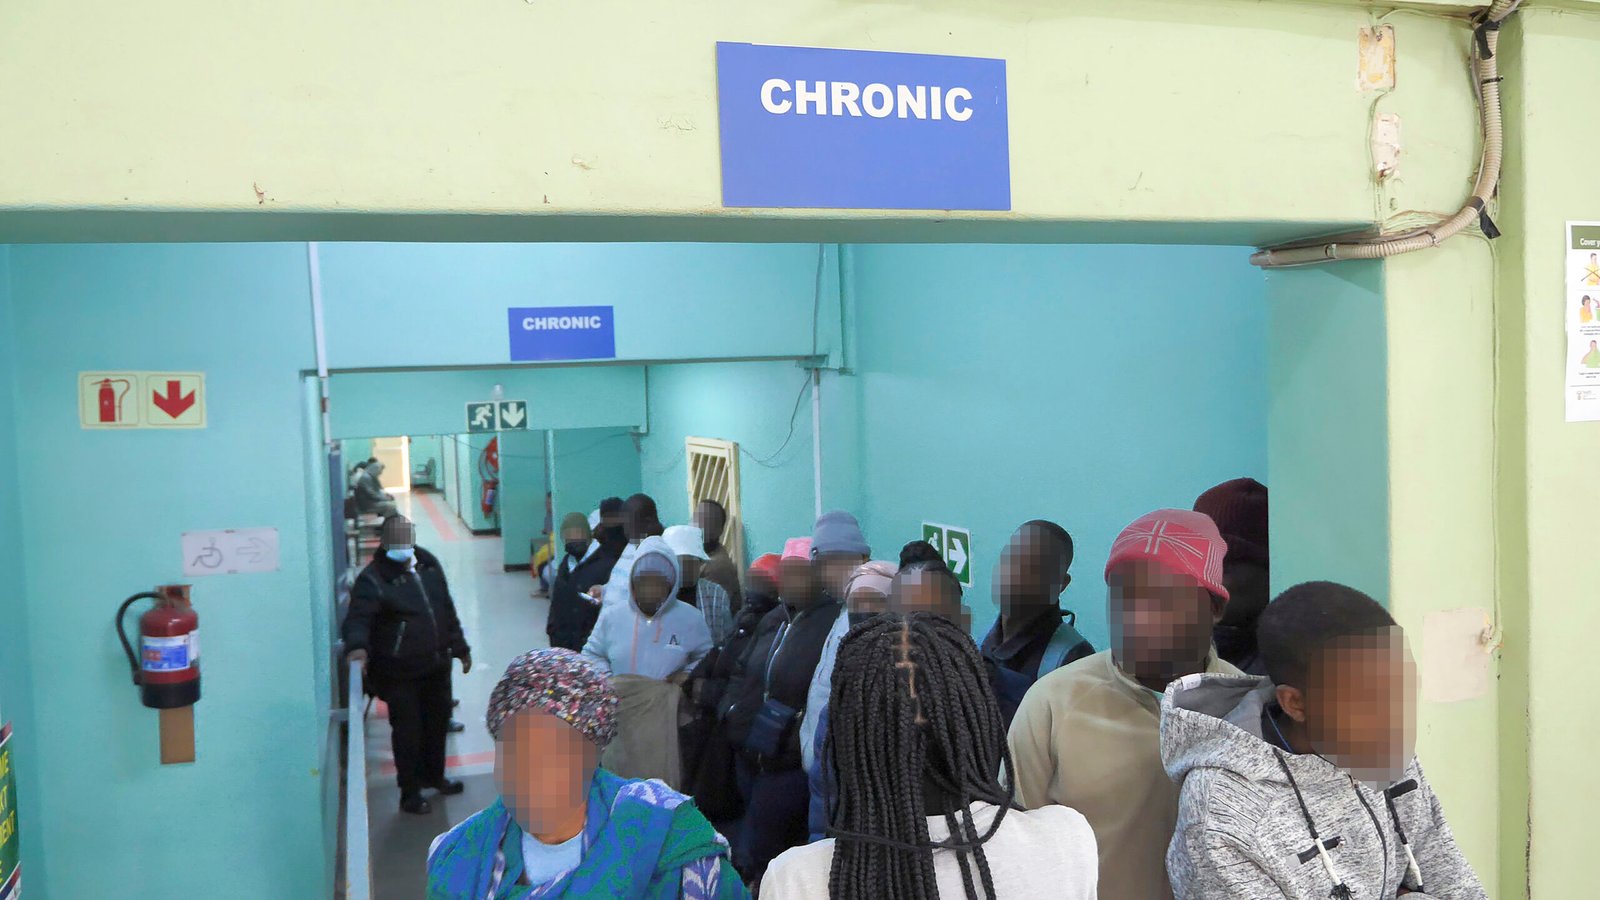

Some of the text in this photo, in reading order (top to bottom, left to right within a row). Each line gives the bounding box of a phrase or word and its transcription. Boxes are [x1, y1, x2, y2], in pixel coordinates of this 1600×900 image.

[760, 78, 973, 122] CHRONIC
[1579, 237, 1596, 246] Cover
[522, 315, 601, 330] CHRONIC
